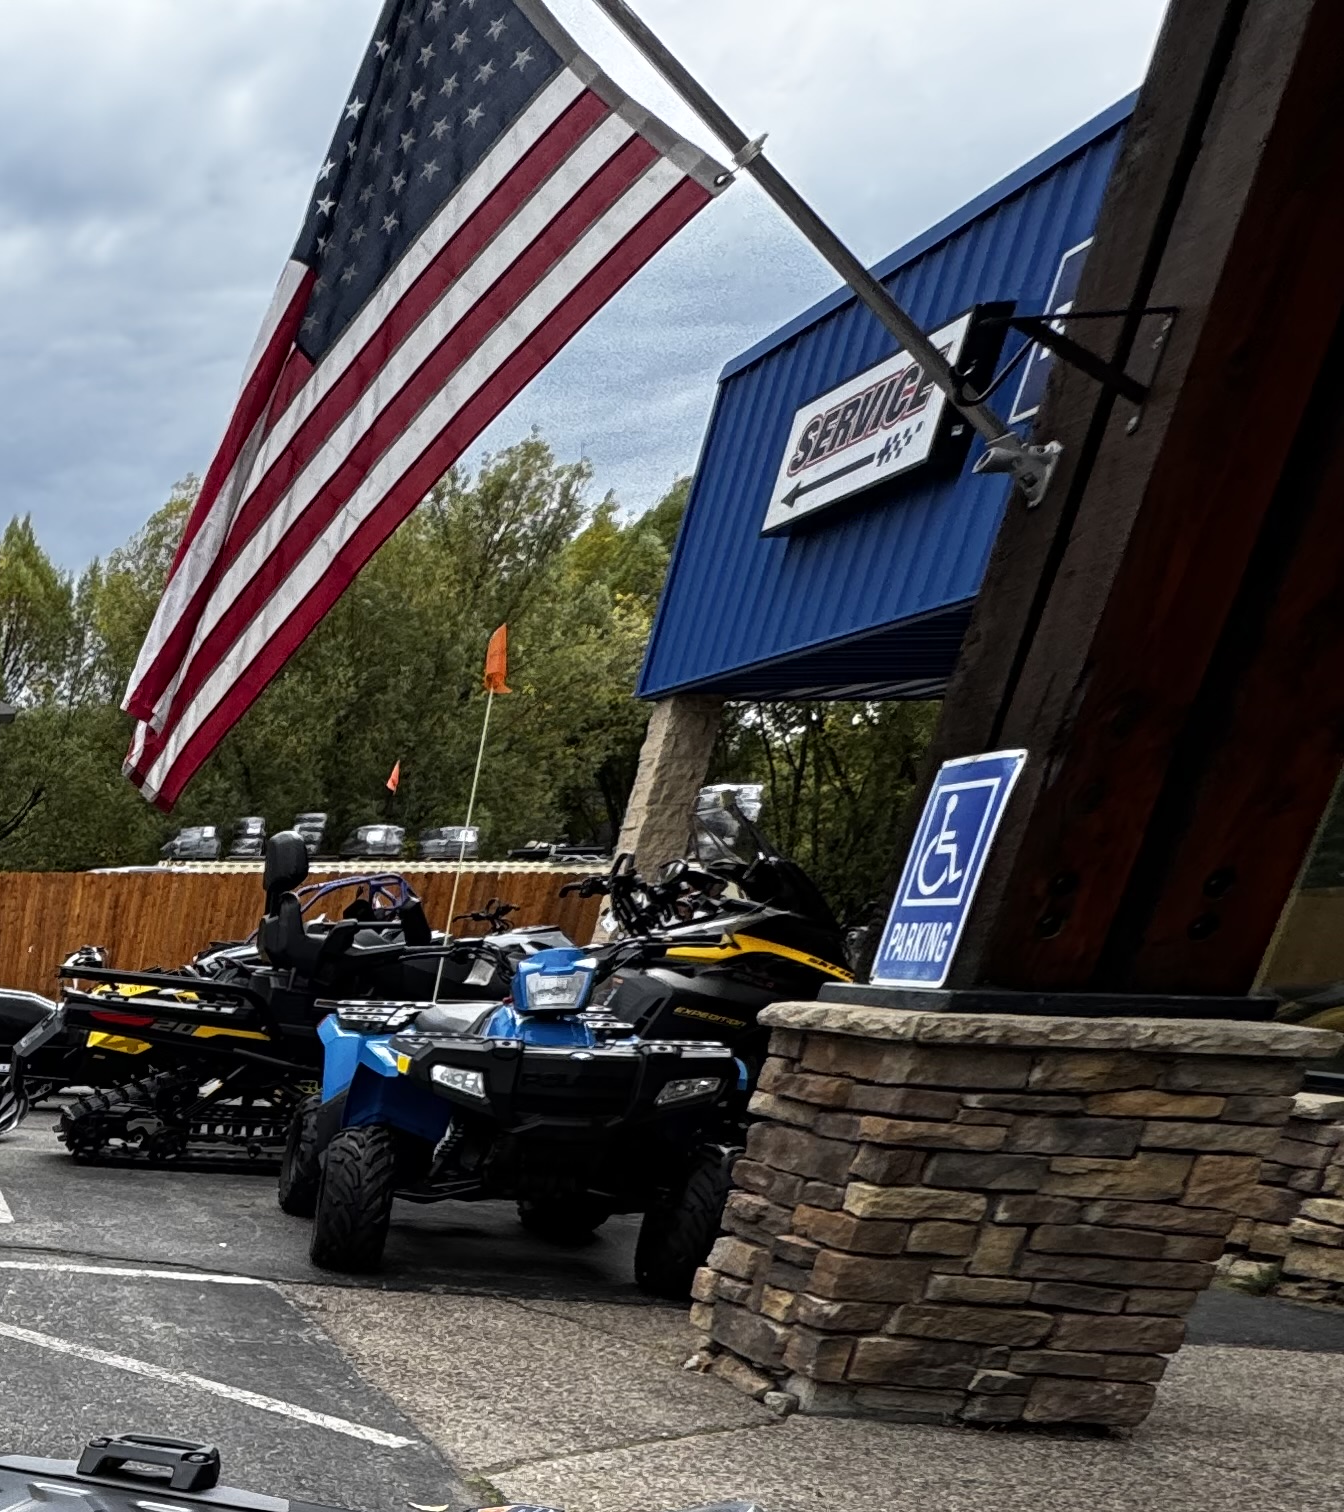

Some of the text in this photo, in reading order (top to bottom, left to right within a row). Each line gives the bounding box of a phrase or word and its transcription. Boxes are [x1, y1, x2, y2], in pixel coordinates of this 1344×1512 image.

[787, 341, 954, 477] SERVICE
[884, 921, 953, 962] PARKING
[673, 1005, 748, 1028] EXPEDITION
